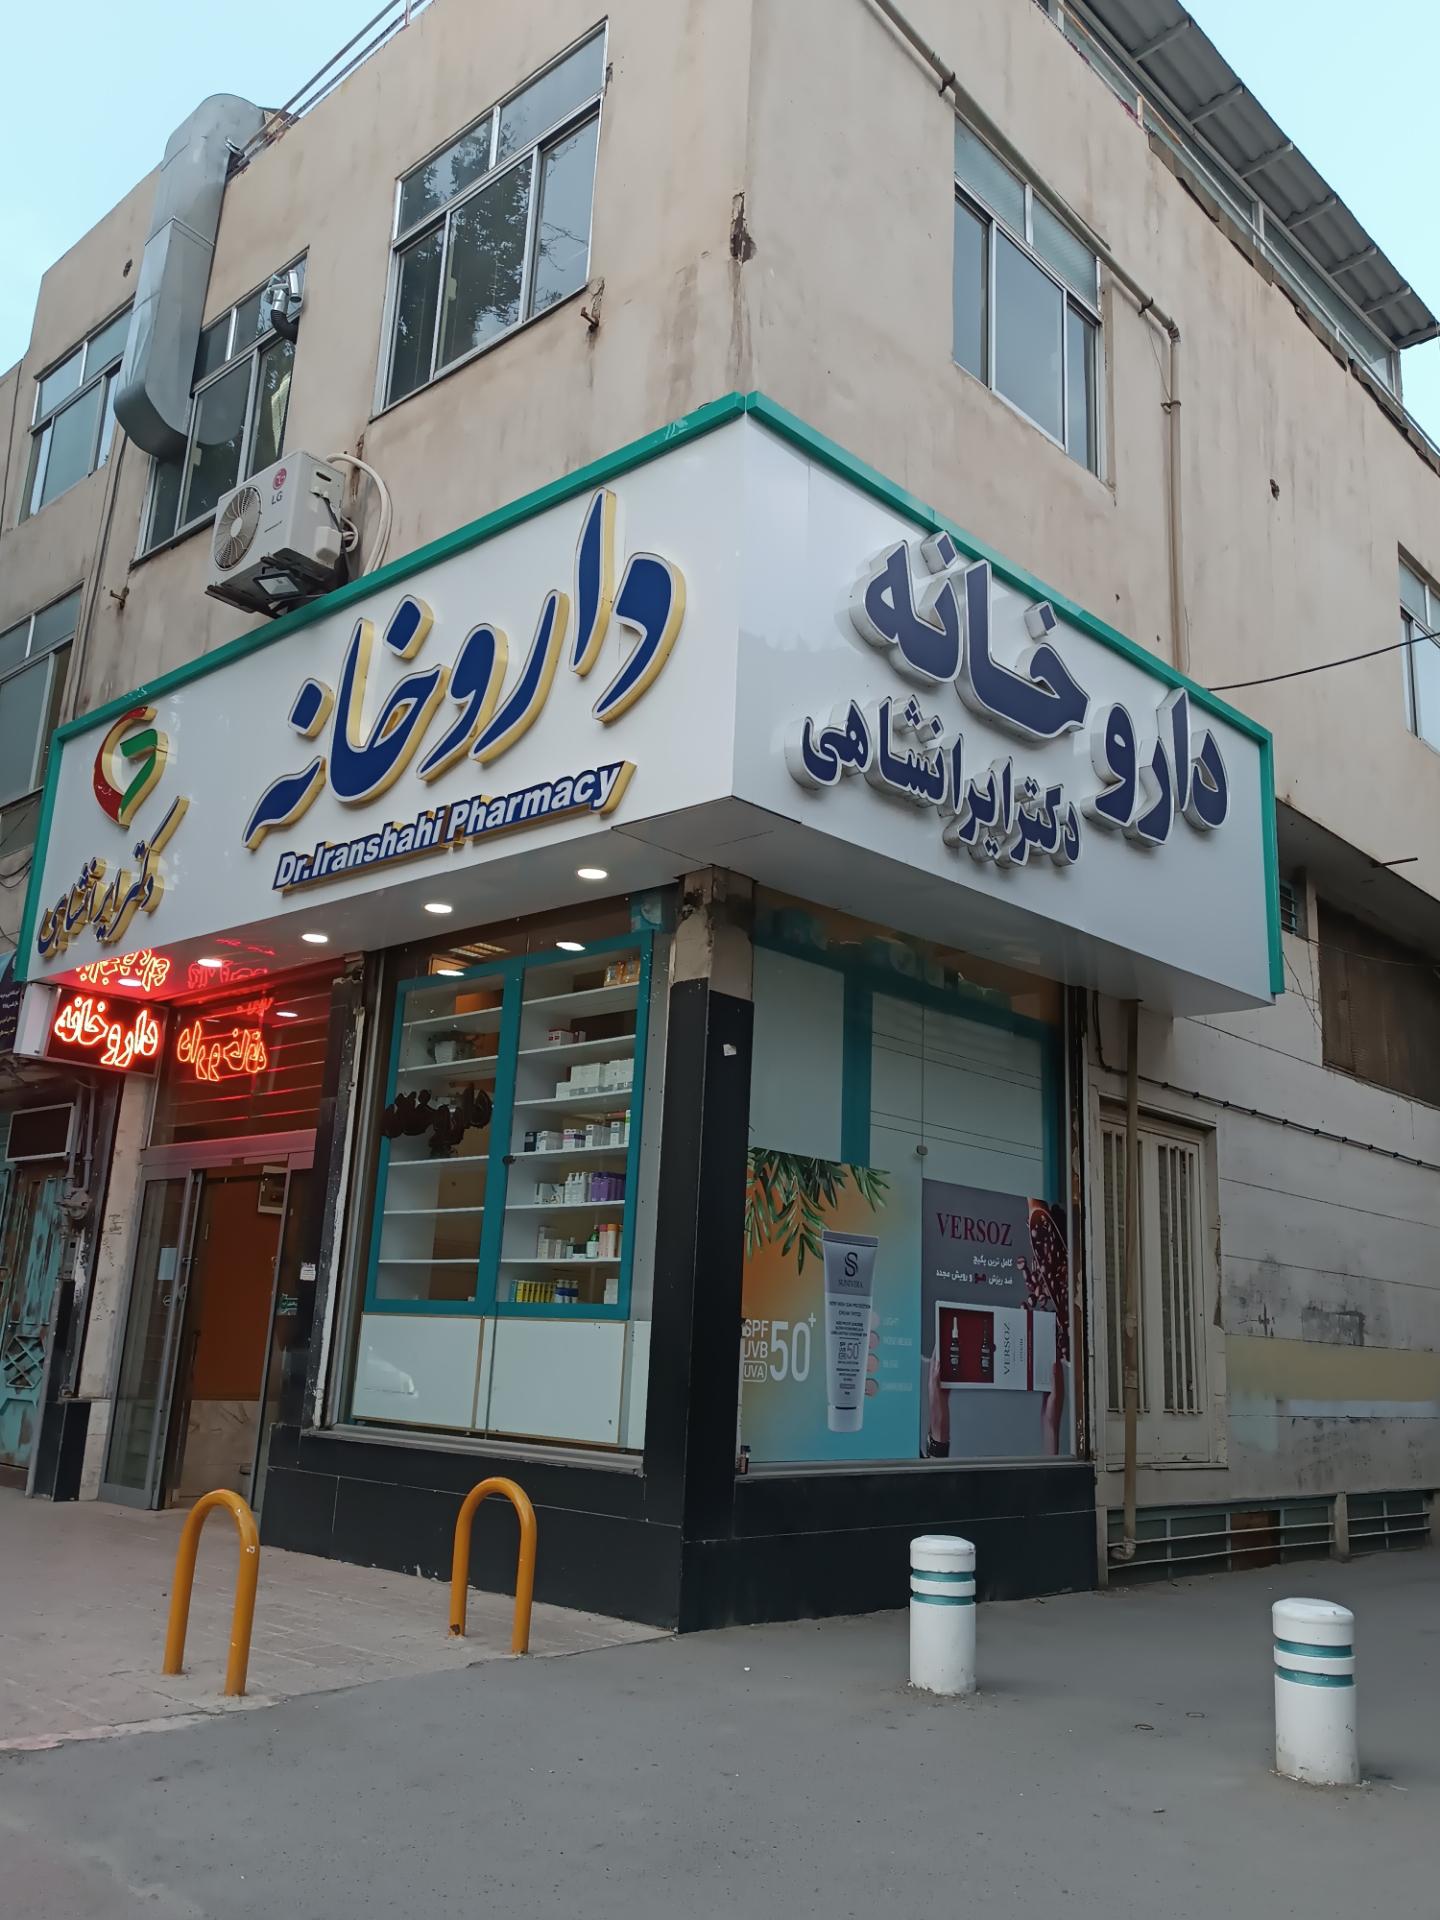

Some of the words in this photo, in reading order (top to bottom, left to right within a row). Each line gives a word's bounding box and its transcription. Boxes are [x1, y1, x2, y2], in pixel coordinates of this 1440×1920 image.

[271, 491, 283, 505] LG
[243, 488, 684, 849] داروخانه
[862, 531, 1231, 846] داروخانه
[801, 695, 1014, 862] ایرانشاهی
[275, 808, 447, 888] Dr.Iranshahi
[447, 764, 621, 838] Pharmacy
[1008, 776, 1080, 867] دکتر
[54, 996, 159, 1067] داروخانه
[936, 1212, 1013, 1247] VERSOZ
[1000, 1257, 1013, 1269] کامل
[743, 1340, 768, 1359] UVB
[744, 1318, 769, 1338] SPF
[744, 1364, 764, 1379] UVA
